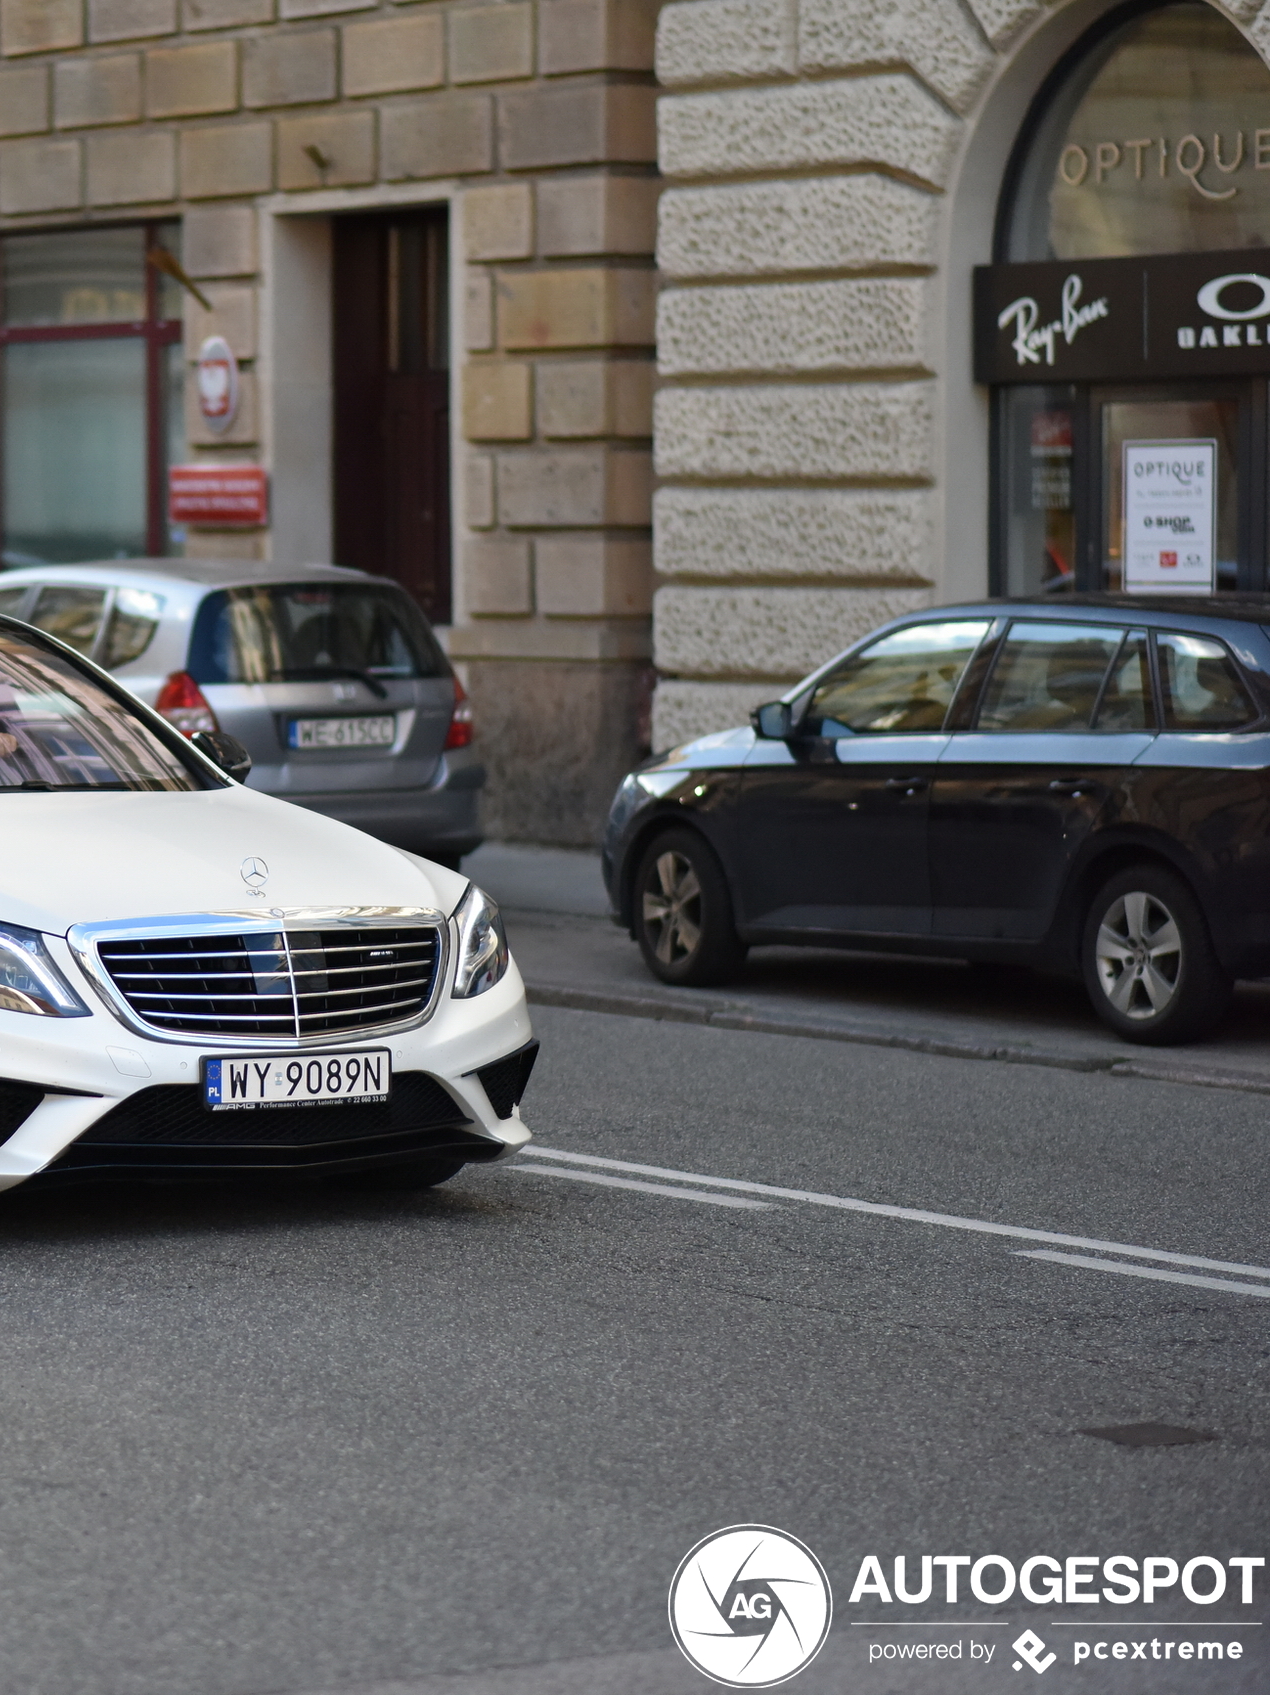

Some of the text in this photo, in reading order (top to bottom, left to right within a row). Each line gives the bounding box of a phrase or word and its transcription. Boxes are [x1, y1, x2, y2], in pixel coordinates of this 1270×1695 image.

[1059, 128, 1270, 200] OPTIQUE
[997, 273, 1109, 367] Ray-Ban
[1177, 323, 1270, 350] OAKL
[1133, 460, 1205, 486] OPTIQUE
[301, 721, 328, 744] WE
[229, 1056, 381, 1098] WY 9089N
[208, 1086, 220, 1097] PL
[259, 1100, 296, 1109] Performance
[297, 1099, 316, 1107] Center
[316, 1098, 344, 1106] Autotrade
